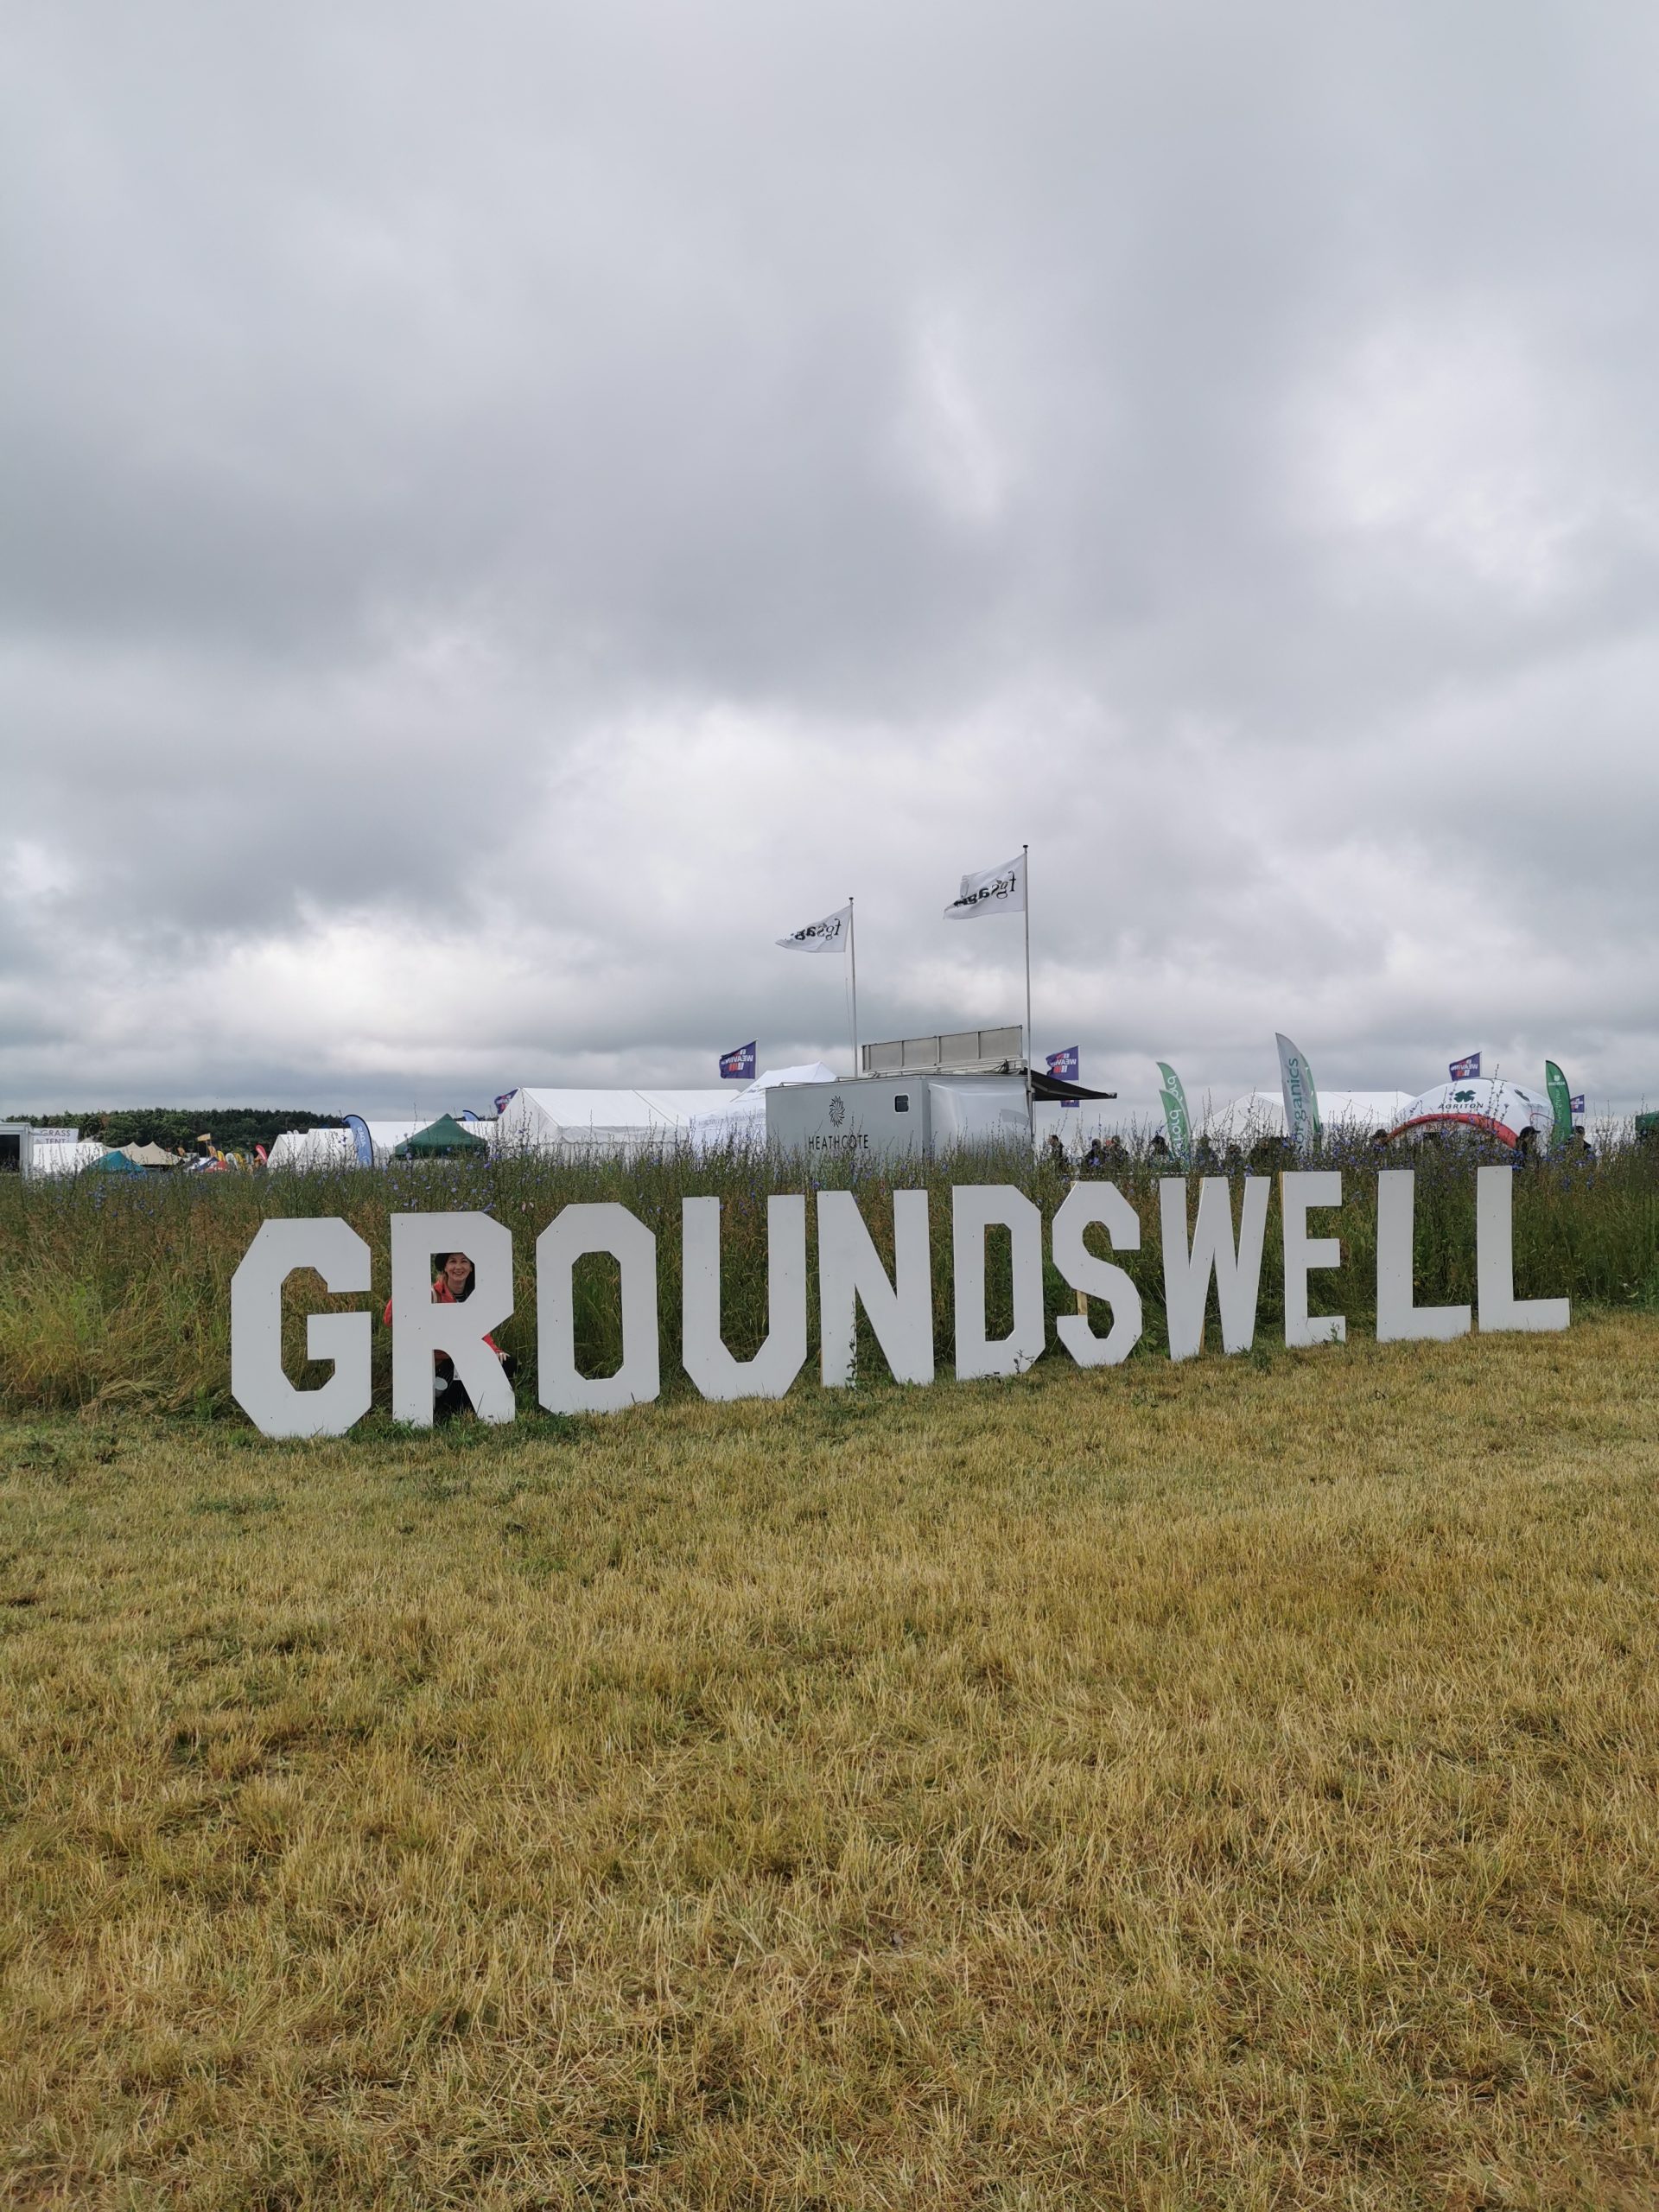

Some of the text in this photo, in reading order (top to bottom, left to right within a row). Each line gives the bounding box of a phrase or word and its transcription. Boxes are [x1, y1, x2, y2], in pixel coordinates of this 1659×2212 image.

[808, 1134, 869, 1150] HEATHCOTE
[1287, 1058, 1308, 1144] organics
[230, 1165, 1571, 1440] GROUNDSWELL
